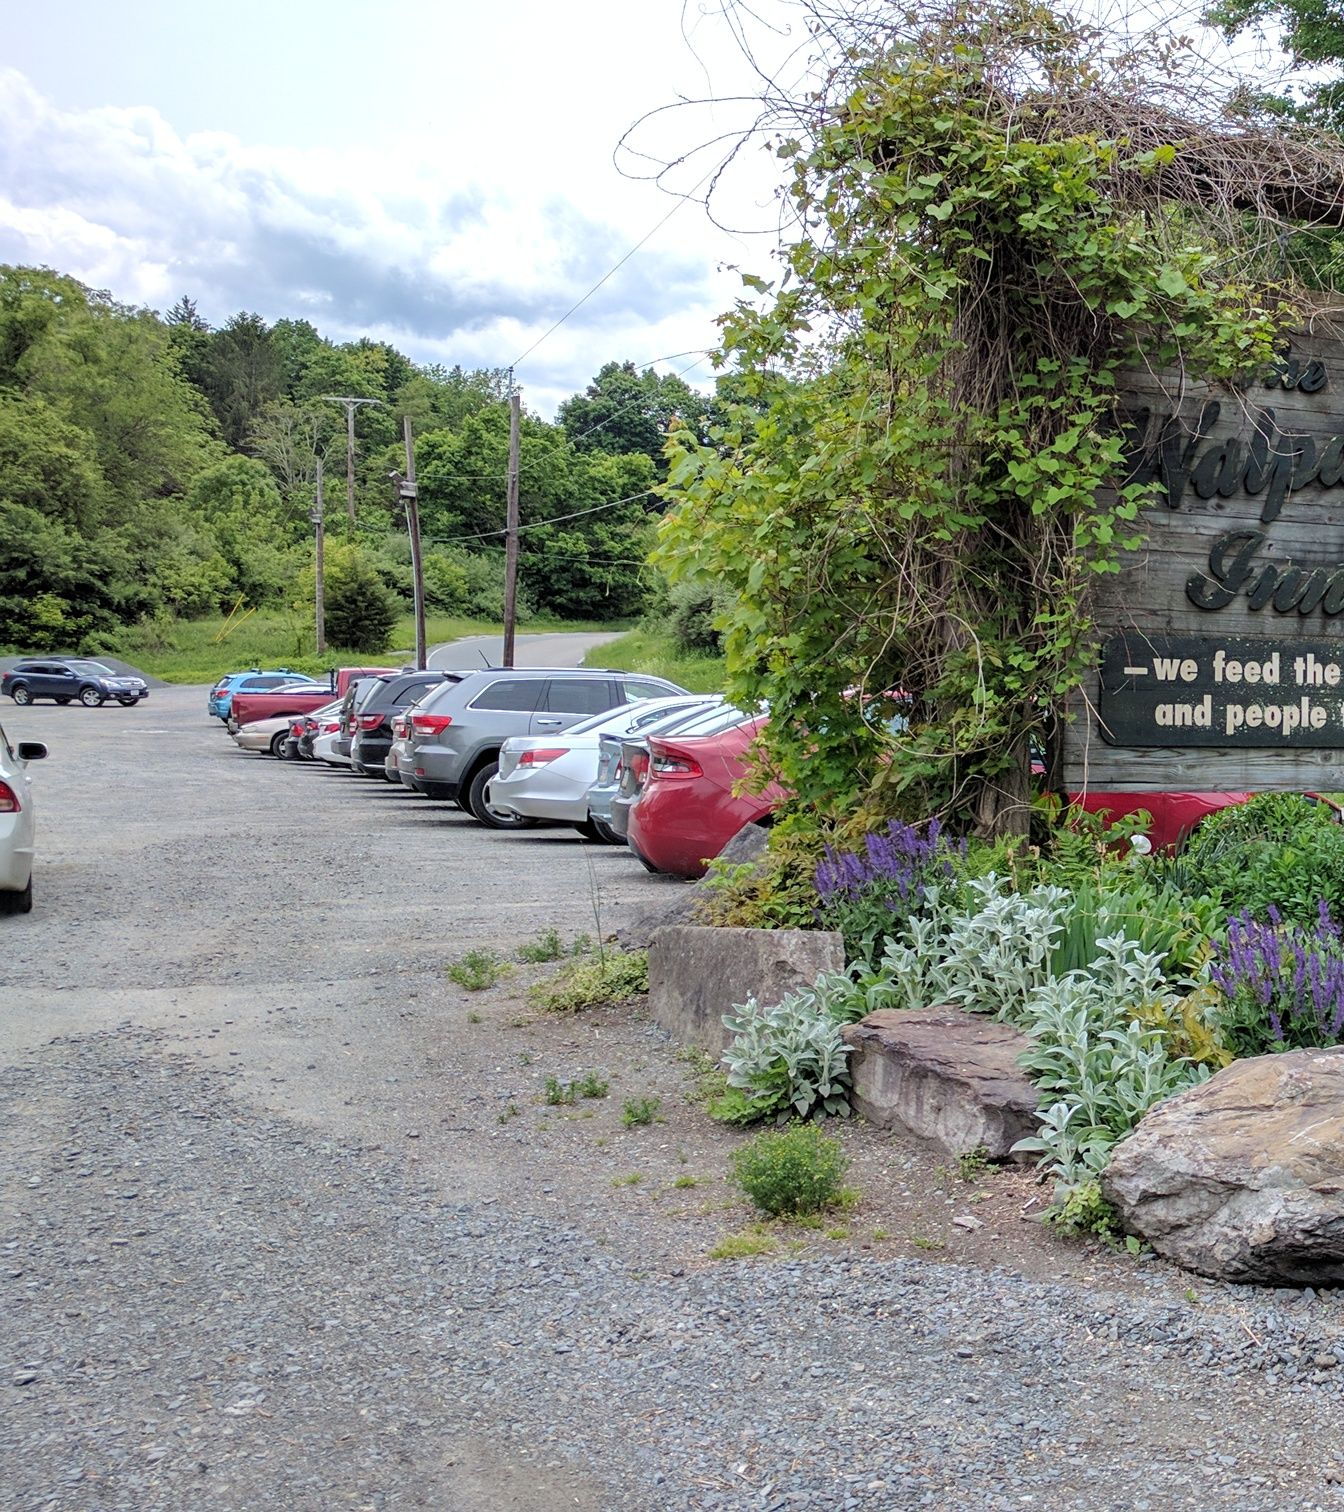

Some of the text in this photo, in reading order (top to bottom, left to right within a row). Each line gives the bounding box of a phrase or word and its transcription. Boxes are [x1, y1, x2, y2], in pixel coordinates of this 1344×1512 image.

[1213, 650, 1280, 683] feed
[1293, 653, 1341, 685] the
[1155, 695, 1212, 726] and
[1226, 697, 1327, 736] people
